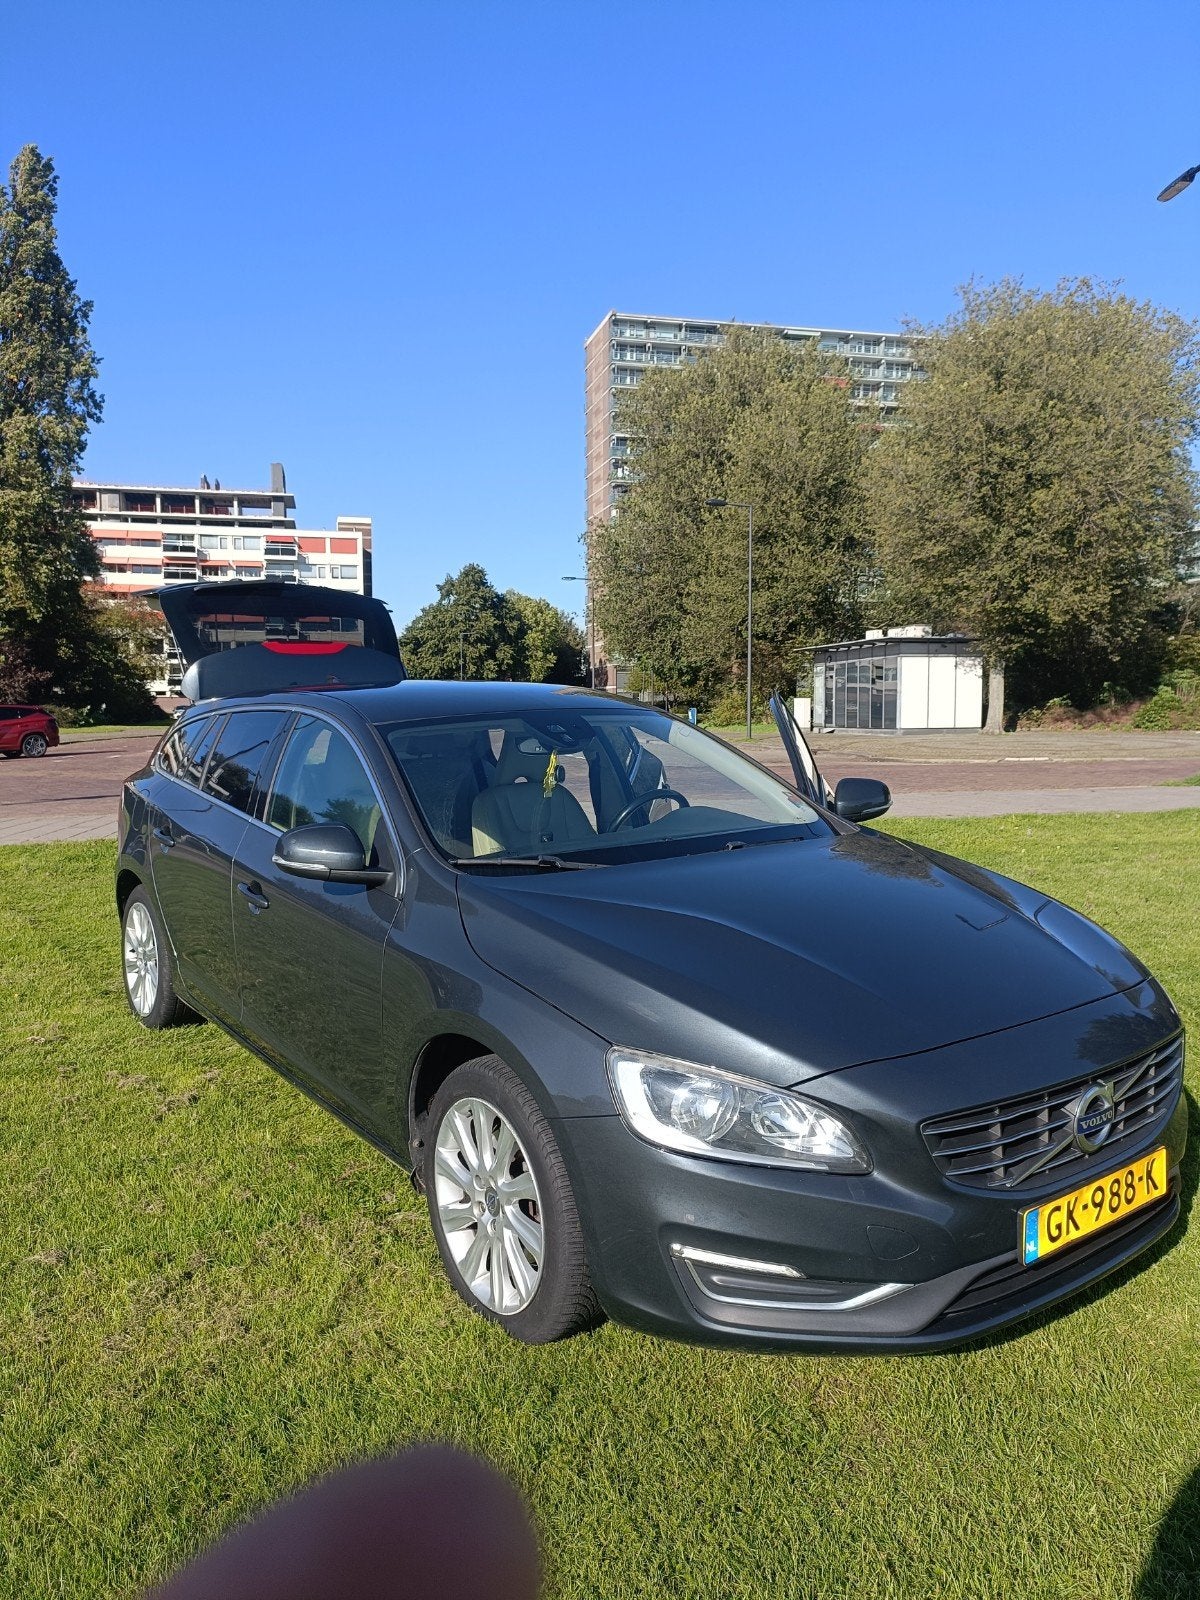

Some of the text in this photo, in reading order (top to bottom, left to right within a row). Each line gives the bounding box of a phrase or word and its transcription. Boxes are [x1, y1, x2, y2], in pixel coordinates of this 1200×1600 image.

[1080, 1110, 1113, 1129] VOLVO
[1047, 1158, 1159, 1244] GK-988-K
[1026, 1241, 1037, 1254] NL
